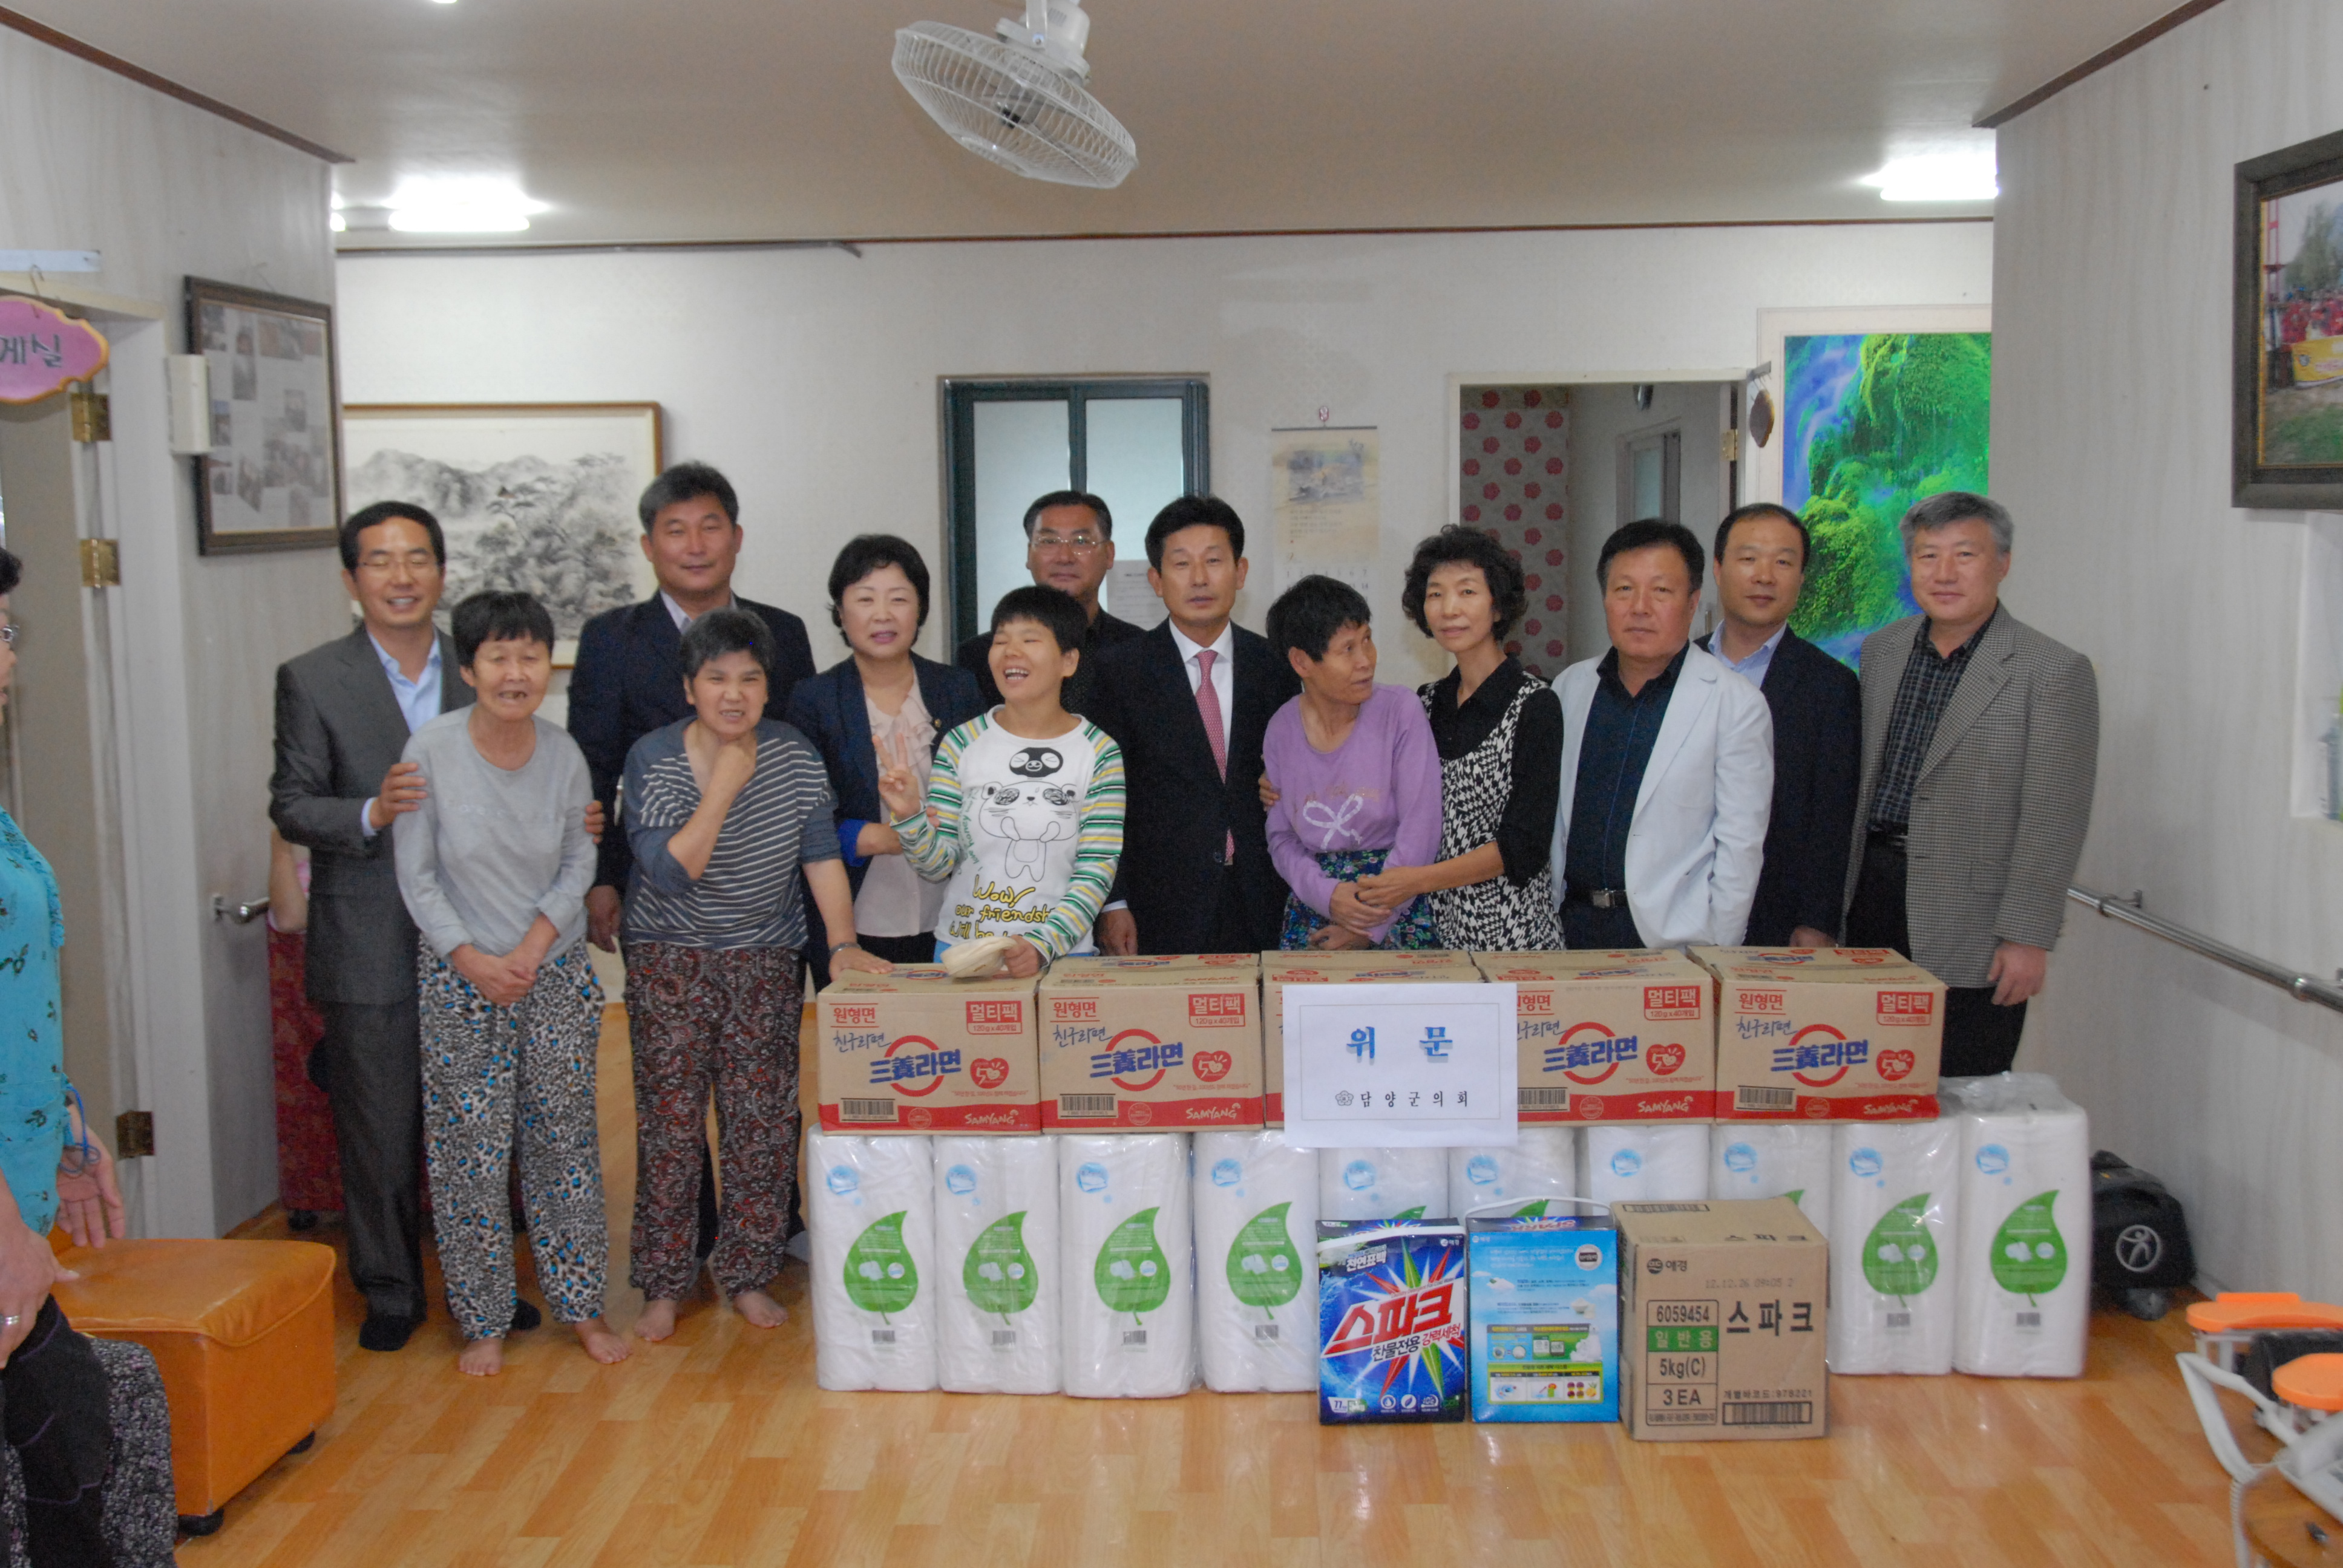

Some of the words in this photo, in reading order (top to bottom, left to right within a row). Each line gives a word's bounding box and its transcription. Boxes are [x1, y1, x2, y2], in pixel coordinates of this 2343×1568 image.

[955, 904, 974, 918] our
[1192, 996, 1241, 1015] 멀티팩
[1648, 988, 1697, 1008] 멀티팩
[1738, 993, 1783, 1010] 원형면
[1881, 993, 1930, 1013] 멀티팩
[833, 1007, 876, 1024] 원형면
[970, 1003, 1018, 1022] 멀티팩
[1053, 1001, 1096, 1018] 원형면
[1665, 1260, 1688, 1272] 애경
[1325, 1282, 1454, 1356] 스파크
[1656, 1304, 1710, 1323] 6059454
[1422, 1322, 1462, 1347] 강력세척
[1372, 1336, 1421, 1362] 찬물전용
[1659, 1356, 1706, 1379] 5kg(C)
